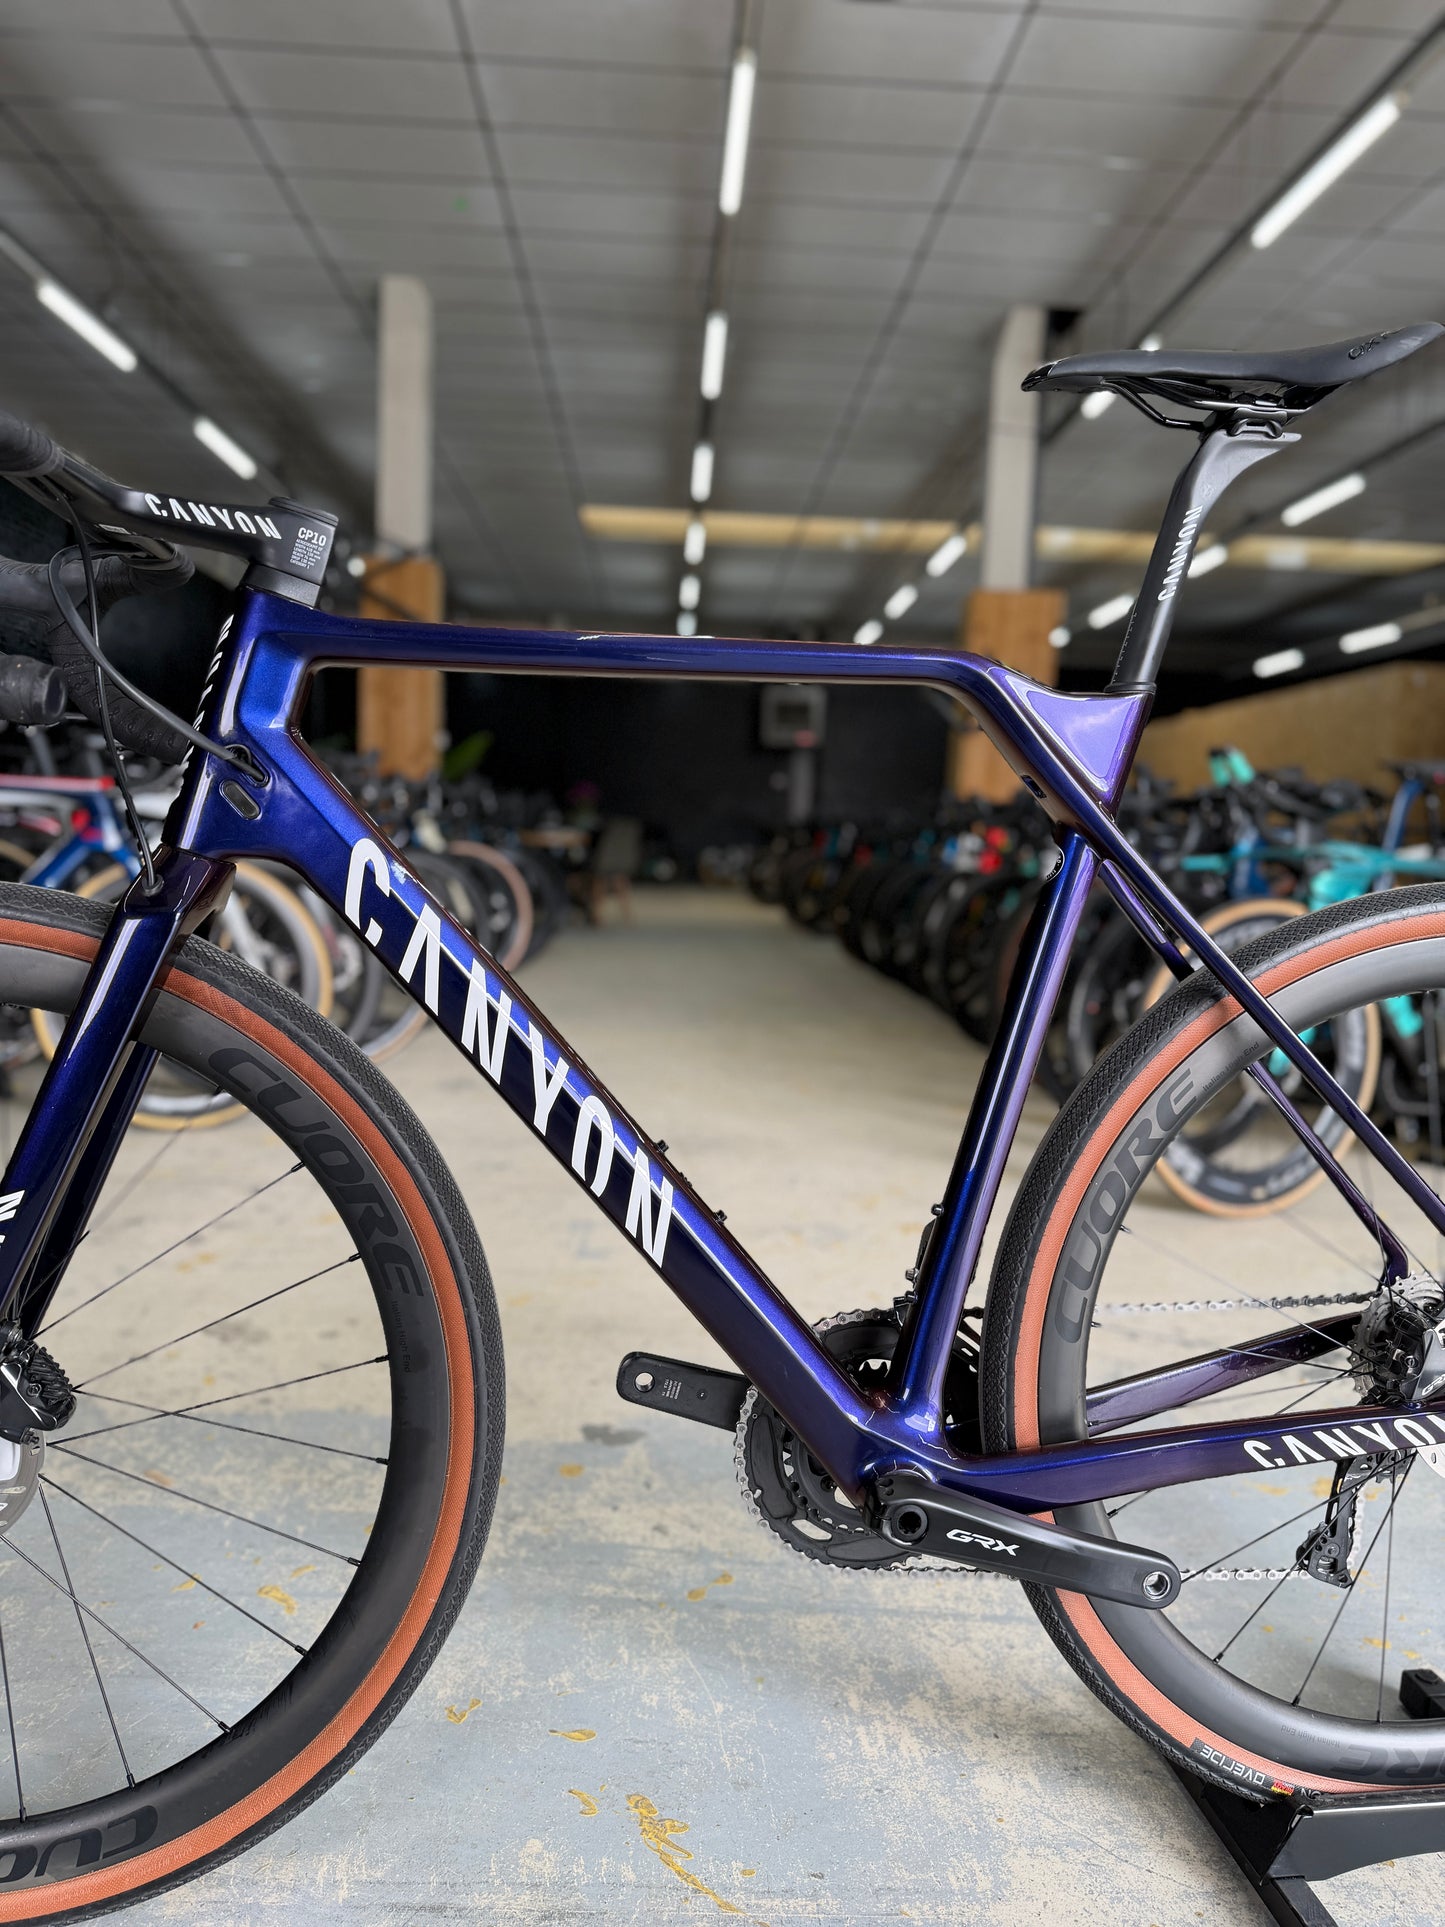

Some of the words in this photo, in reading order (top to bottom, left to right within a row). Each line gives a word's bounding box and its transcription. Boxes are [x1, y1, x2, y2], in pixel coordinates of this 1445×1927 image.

[144, 493, 282, 539] CANYON
[298, 527, 327, 546] CP10
[1158, 505, 1203, 601] CANYON
[344, 838, 674, 1268] CANYON
[1243, 1041, 1260, 1057] End
[208, 1047, 424, 1298] CUORE
[1054, 1067, 1198, 1344] CUORE
[946, 1528, 1021, 1557] GRX
